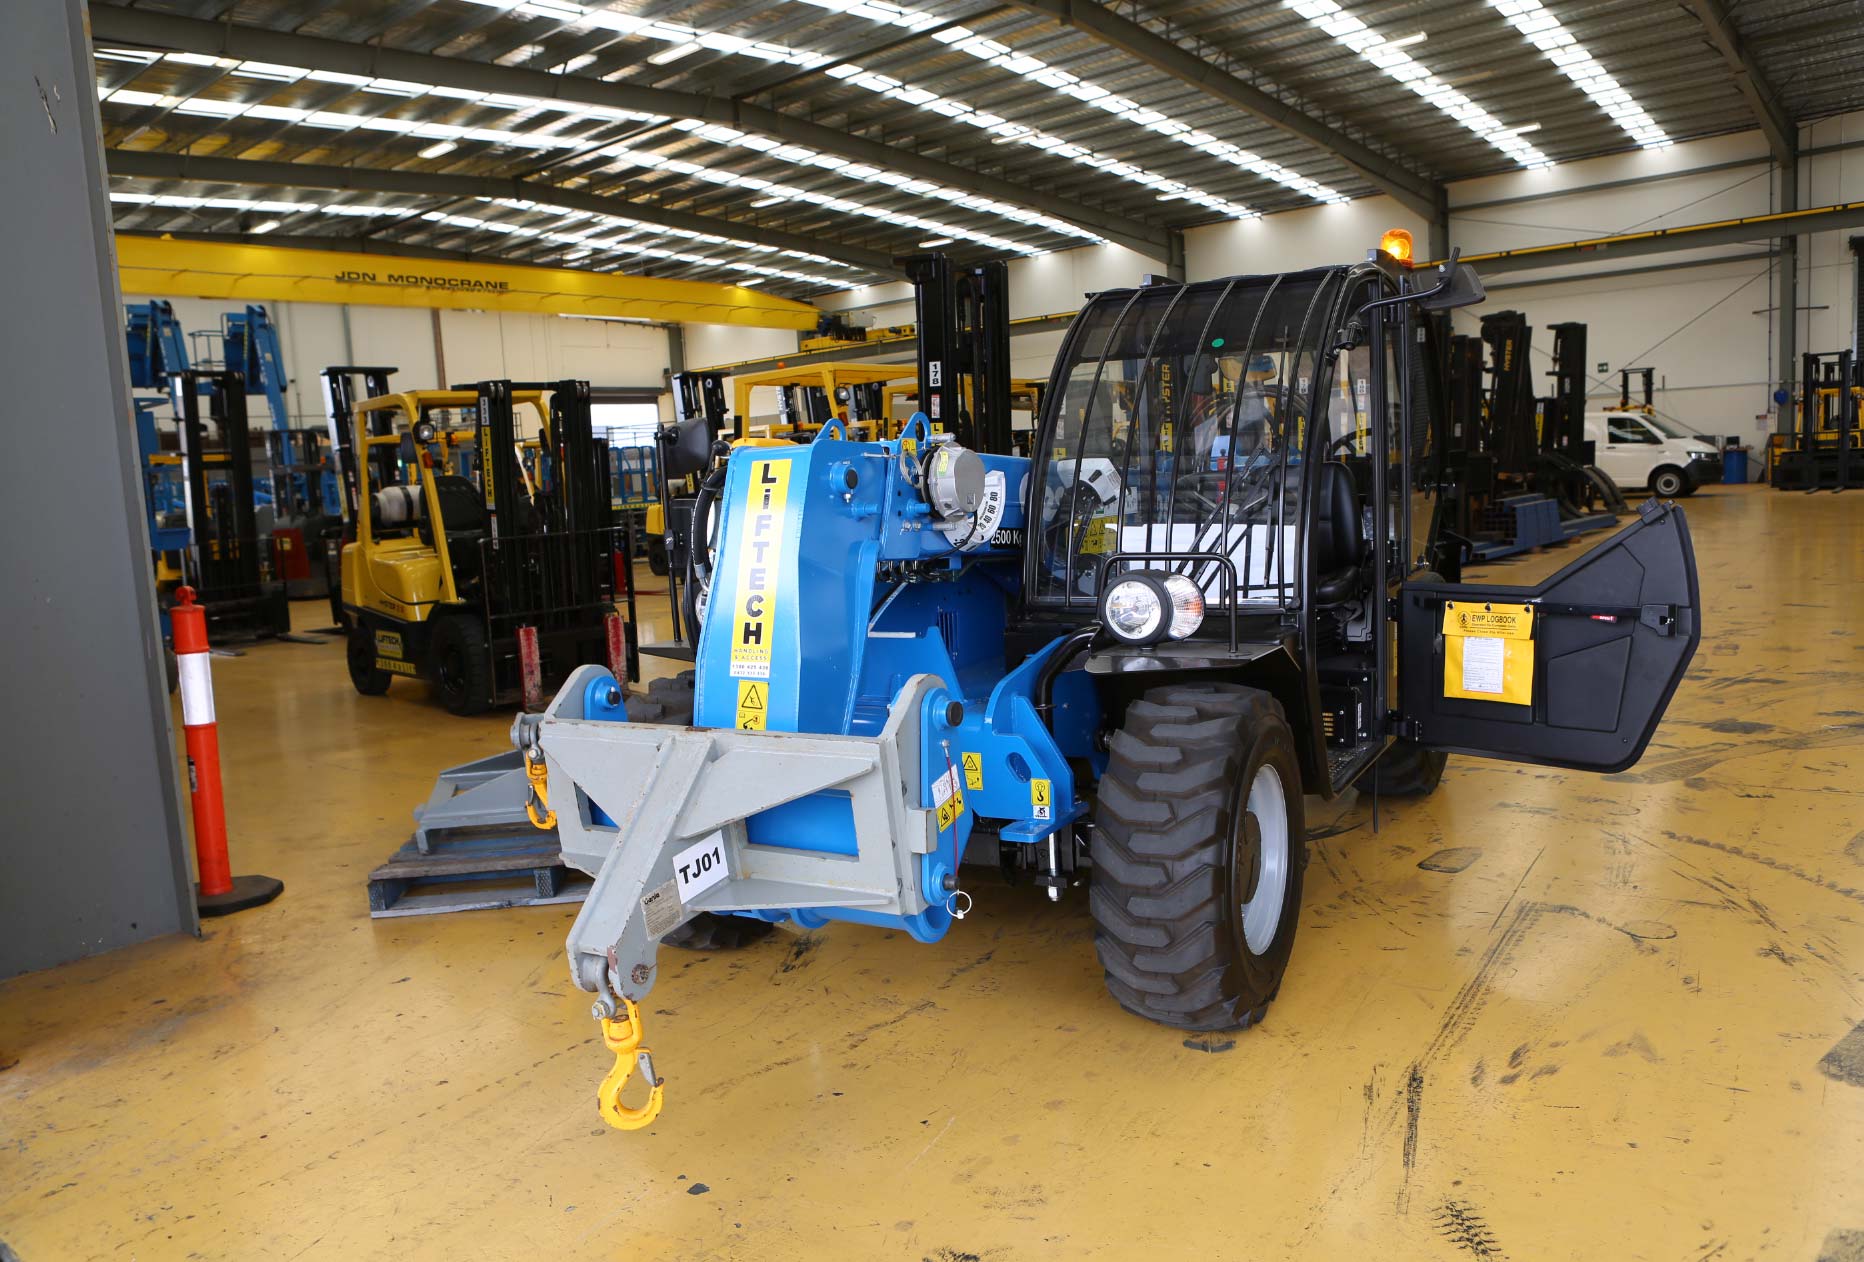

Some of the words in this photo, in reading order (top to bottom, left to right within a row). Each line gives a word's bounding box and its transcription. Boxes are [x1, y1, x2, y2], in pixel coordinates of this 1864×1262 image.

[387, 274, 509, 290] MONOCRANE
[931, 363, 939, 385] 178
[990, 491, 998, 502] 80
[988, 504, 997, 515] 60
[990, 529, 1012, 545] 2500
[1471, 614, 1486, 622] EWP
[1486, 615, 1517, 623] LOGBOOK
[678, 846, 721, 885] TJ01
